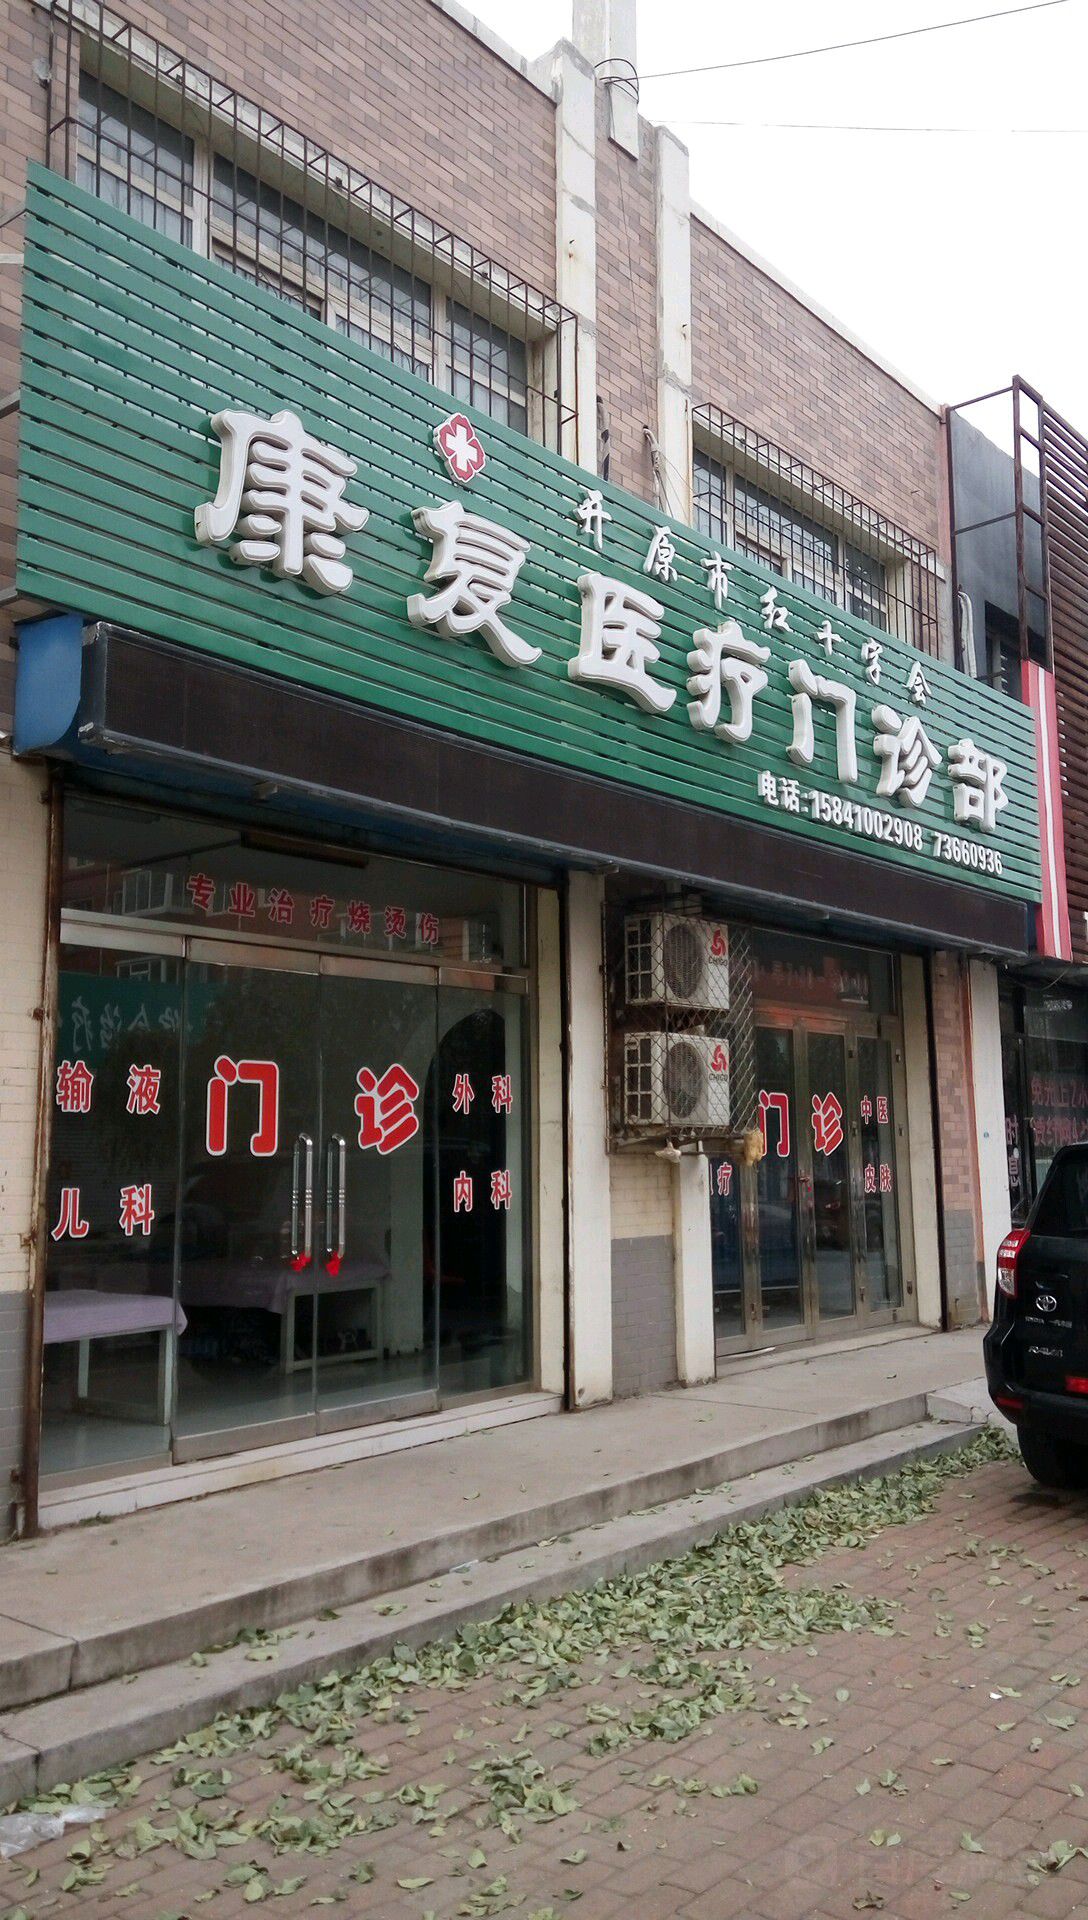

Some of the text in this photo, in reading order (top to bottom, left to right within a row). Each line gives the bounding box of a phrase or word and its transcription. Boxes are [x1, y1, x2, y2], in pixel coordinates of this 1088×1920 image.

[195, 409, 1009, 832] 康复医疗门诊部
[573, 488, 932, 706] 开原市红十字会
[930, 831, 1003, 875] 73660936
[187, 872, 439, 945] 专业治疗烧烫伤
[56, 1060, 162, 1114] 输液
[206, 1055, 420, 1157] 门诊
[452, 1073, 513, 1114] 外科
[860, 1095, 889, 1125] 中医
[758, 1089, 844, 1157] 门诊
[452, 1170, 512, 1212] 内科
[864, 1163, 892, 1194] 皮肤
[52, 1183, 155, 1241] 儿科
